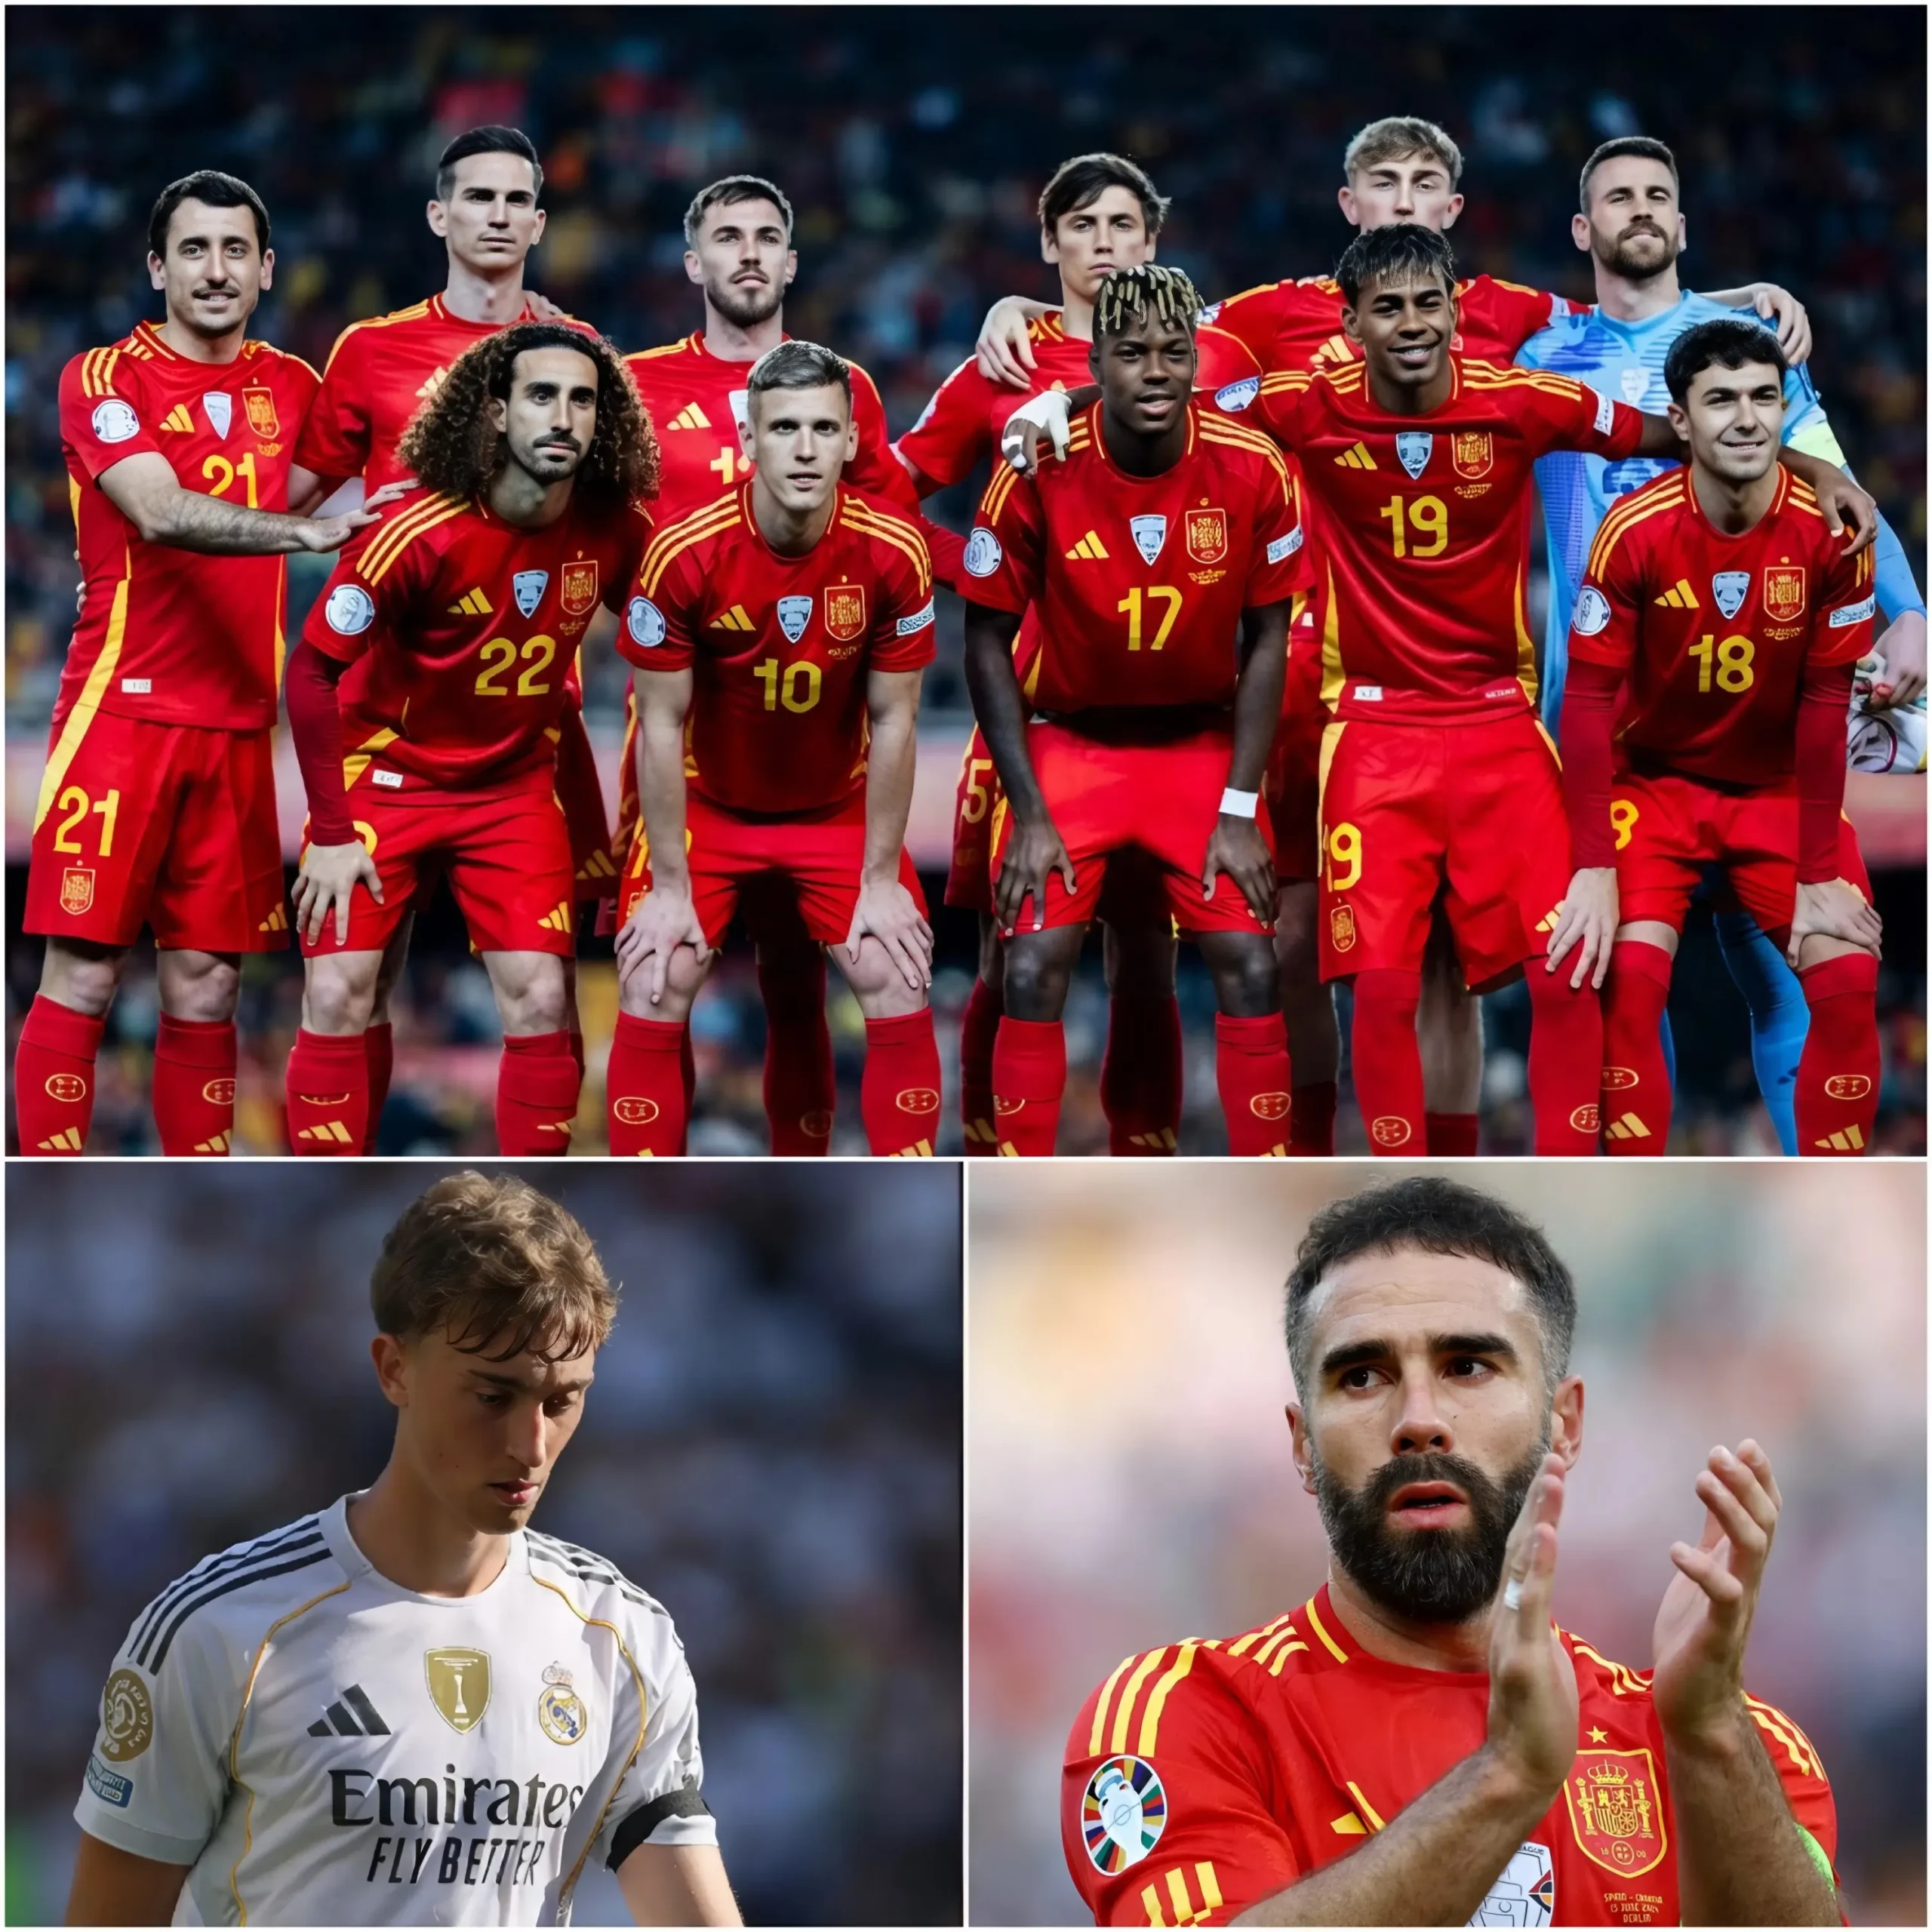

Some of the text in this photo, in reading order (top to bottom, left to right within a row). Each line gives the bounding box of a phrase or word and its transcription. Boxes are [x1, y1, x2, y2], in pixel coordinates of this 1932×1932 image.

[202, 453, 258, 510] 21
[1380, 495, 1448, 558] 19
[1118, 586, 1183, 651] 17
[475, 635, 555, 695] 22
[754, 658, 822, 713] 10
[1689, 635, 1755, 693] 18
[54, 786, 120, 857] 21
[328, 1763, 583, 1829] Emirates
[367, 1836, 434, 1884] FLY
[438, 1837, 545, 1886] BETTER
